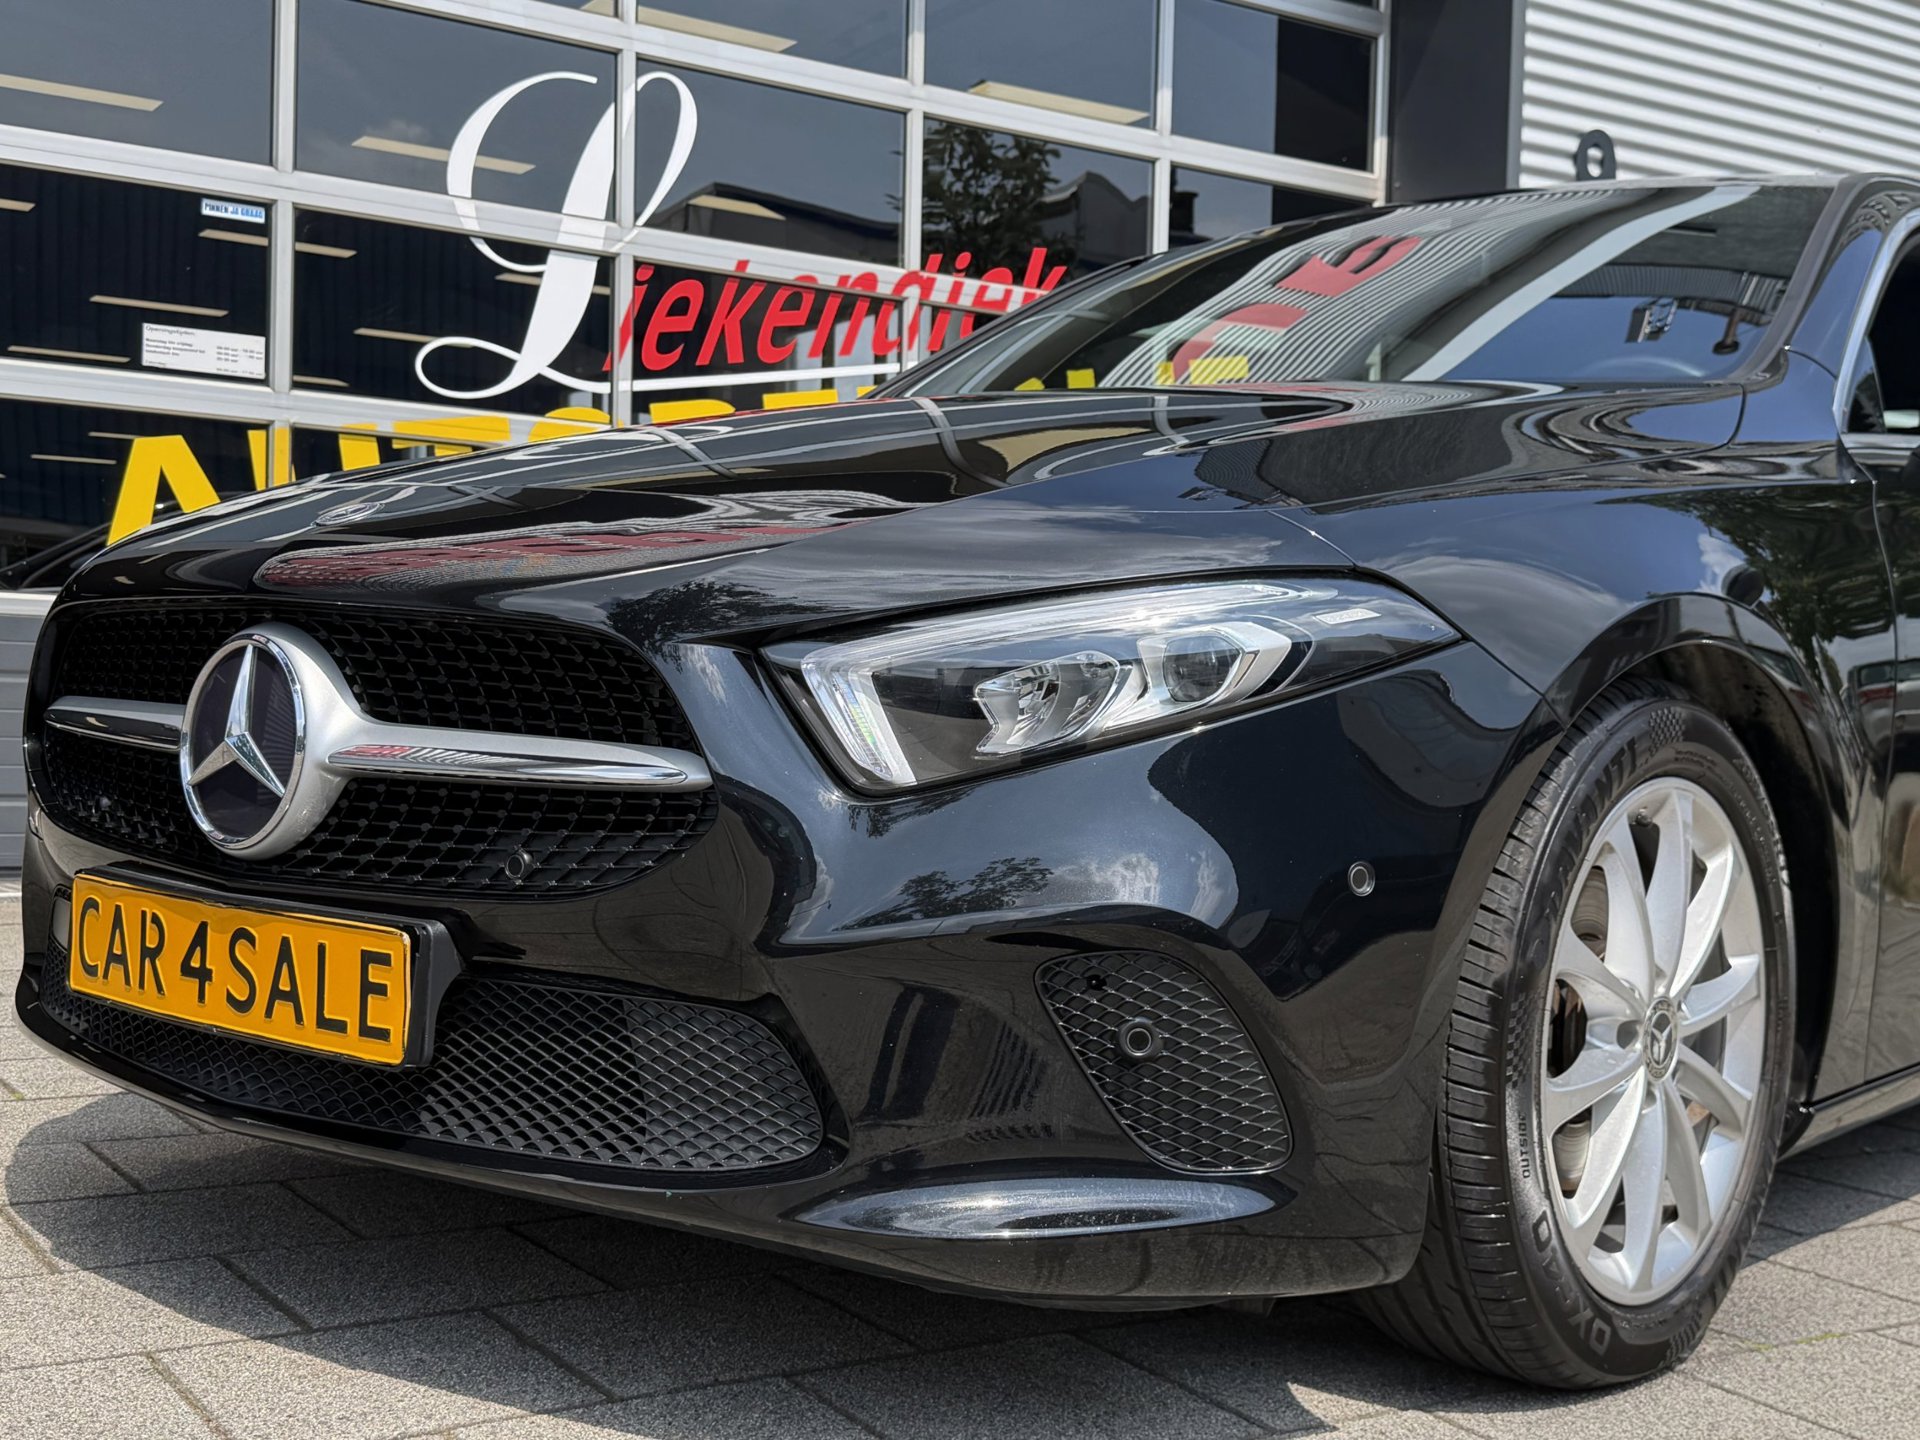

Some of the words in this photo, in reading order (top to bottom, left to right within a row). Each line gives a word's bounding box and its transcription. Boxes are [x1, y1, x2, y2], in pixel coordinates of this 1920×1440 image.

[204, 202, 229, 213] PINNEN
[78, 896, 166, 996] CAR
[180, 920, 214, 1004] 4
[225, 927, 392, 1042] SALE
[1518, 1111, 1530, 1179] OUTSIDE
